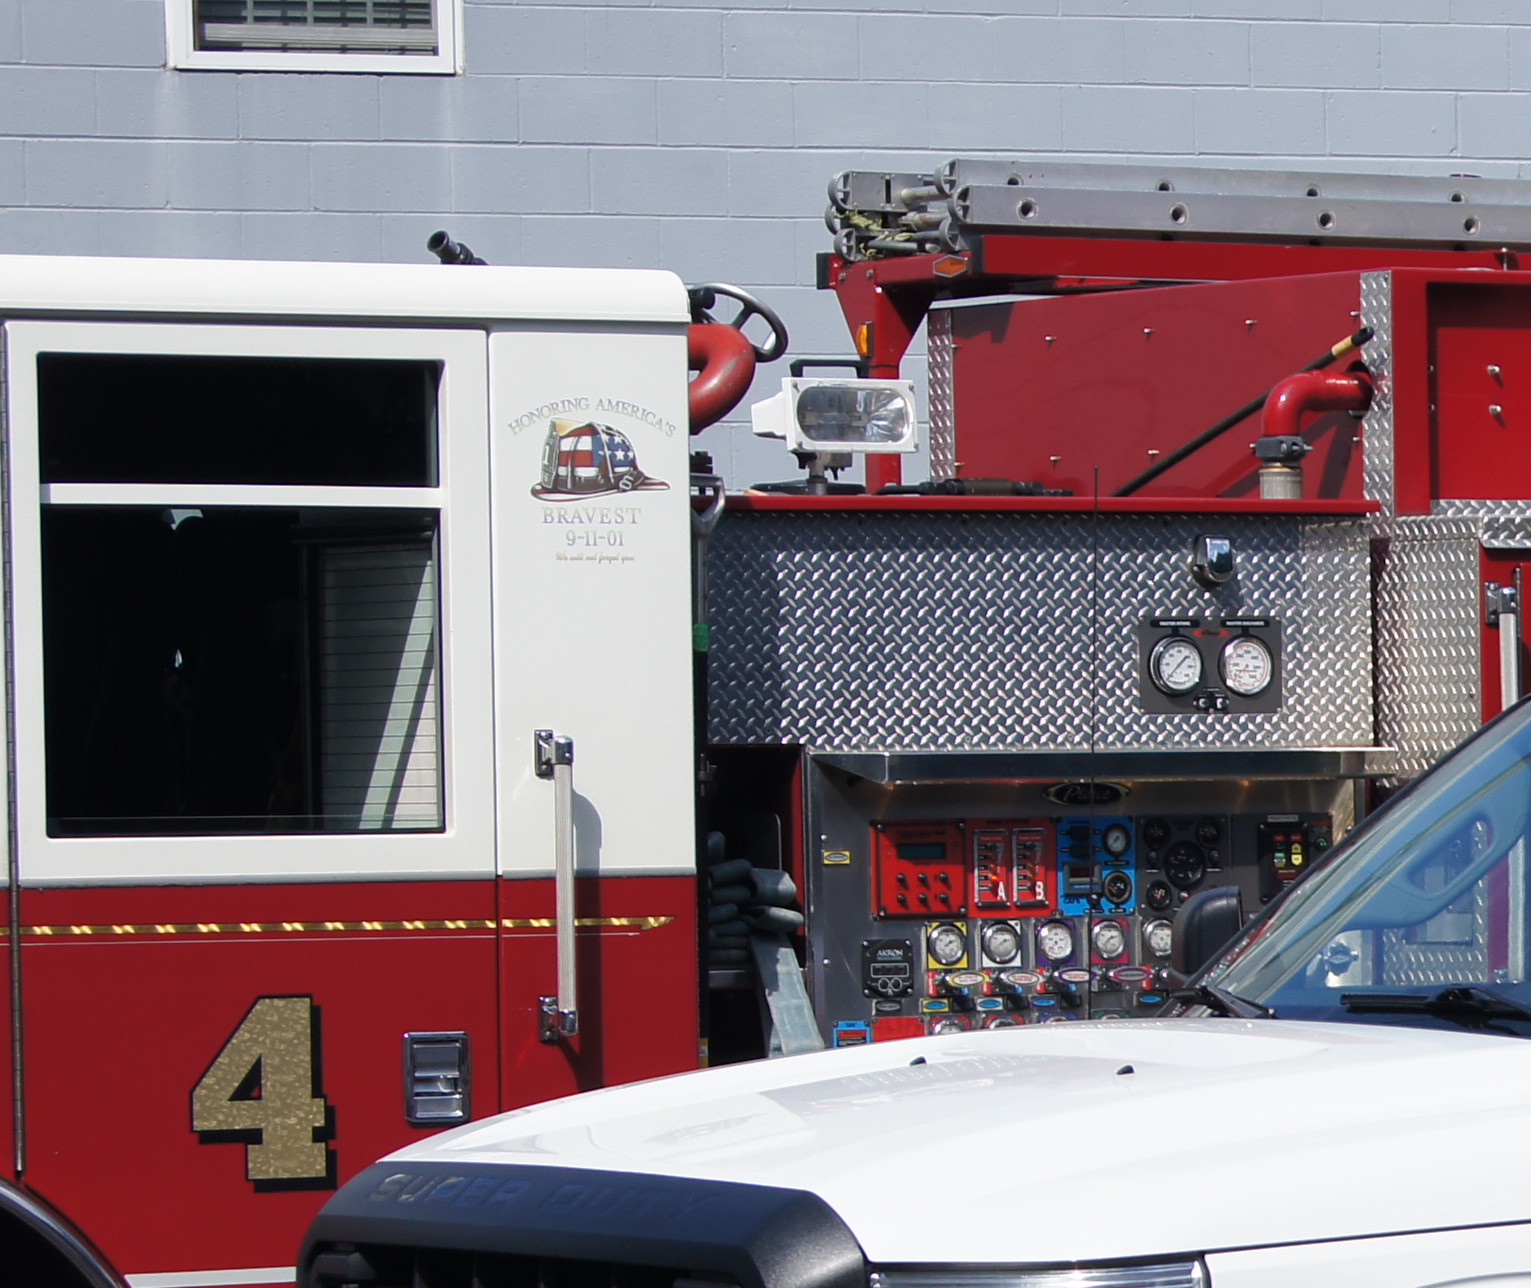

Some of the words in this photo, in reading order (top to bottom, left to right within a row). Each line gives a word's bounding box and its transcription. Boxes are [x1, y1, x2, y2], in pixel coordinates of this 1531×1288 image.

[507, 397, 590, 435] HONORING
[596, 398, 676, 437] AMERICA'S
[542, 507, 642, 524] BRAVEST
[566, 530, 624, 546] 9-11-01
[997, 881, 1007, 901] A
[1035, 881, 1045, 901] B
[877, 949, 903, 957] AKRON
[190, 994, 333, 1188] 4
[366, 1173, 533, 1206] SUPER
[538, 1183, 720, 1219] DUTY
